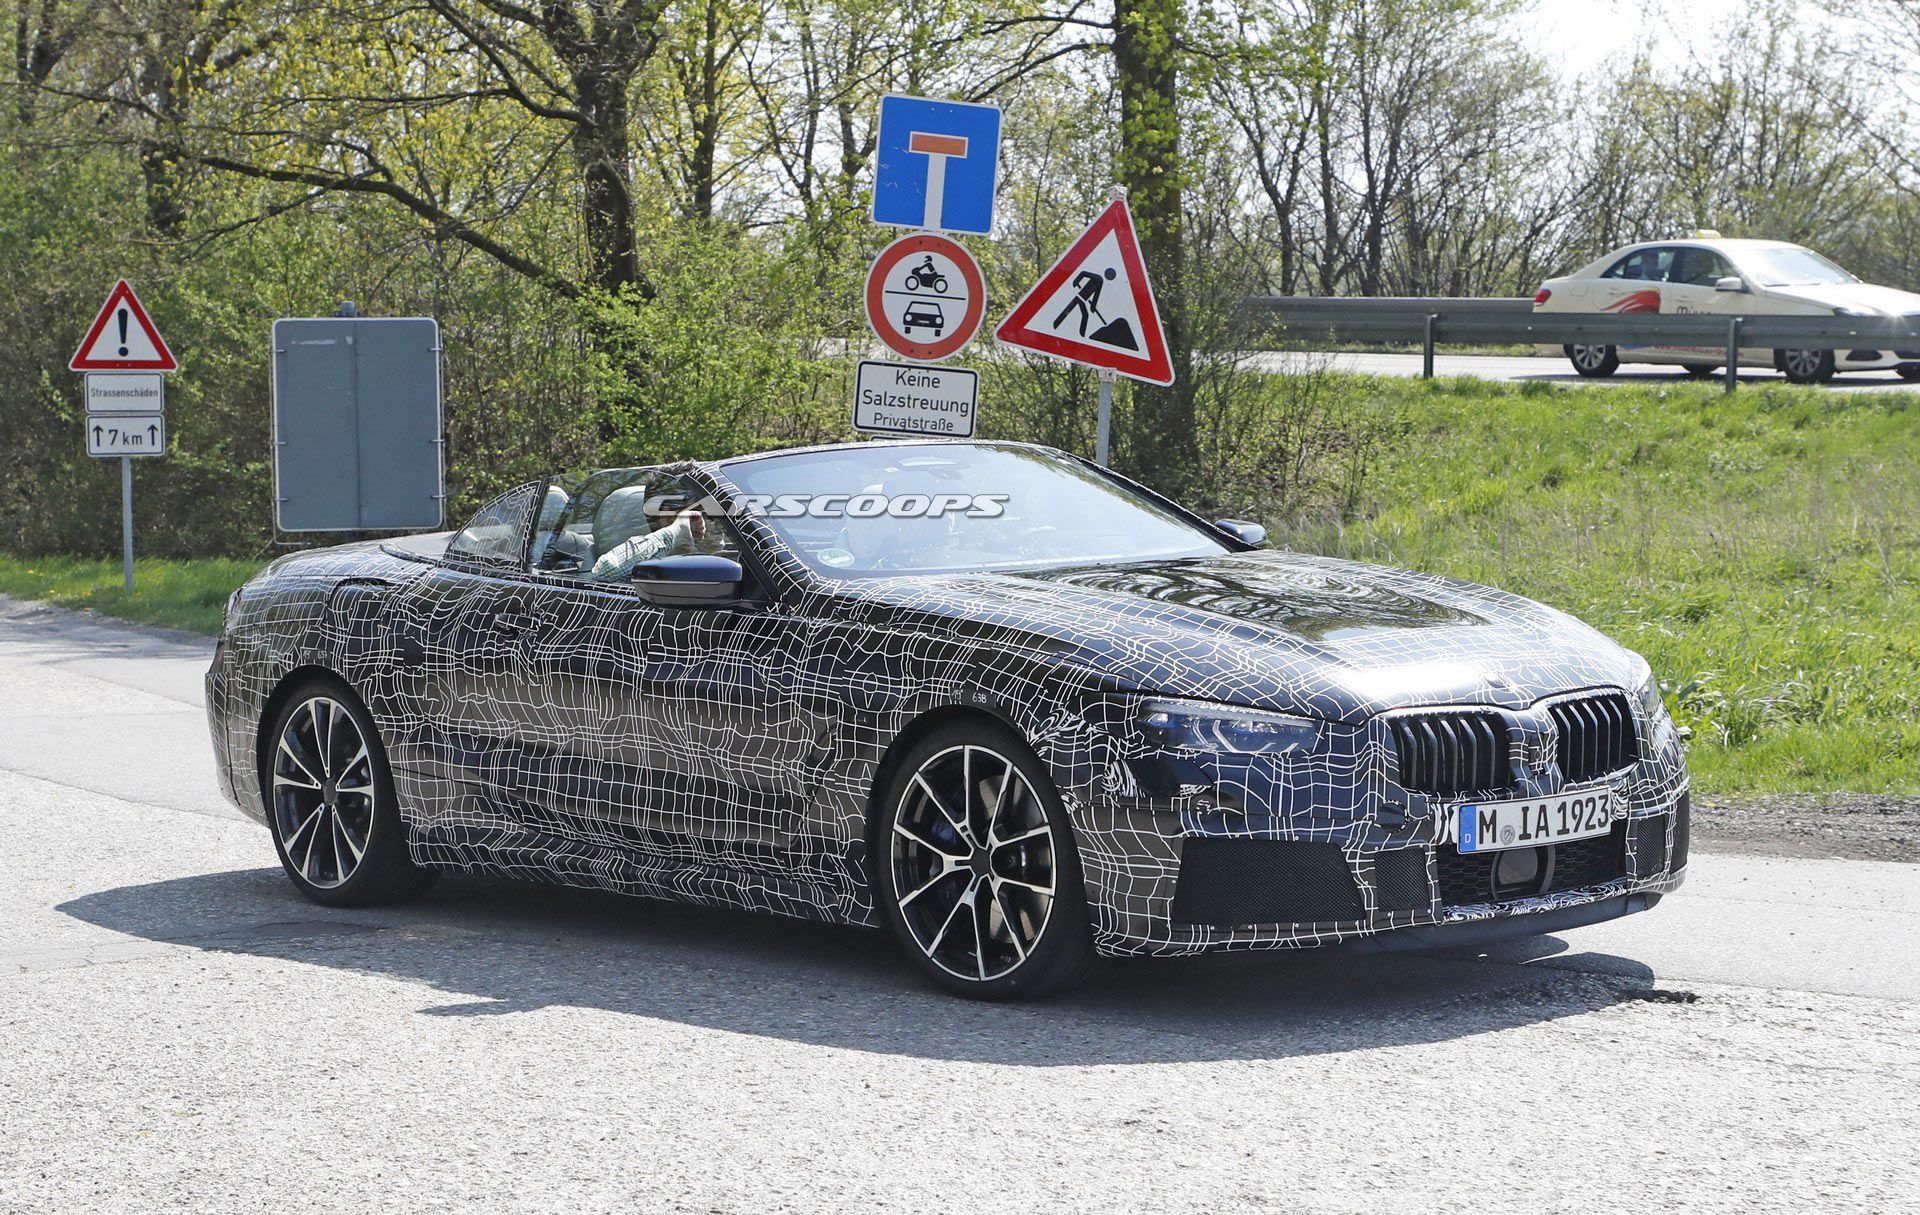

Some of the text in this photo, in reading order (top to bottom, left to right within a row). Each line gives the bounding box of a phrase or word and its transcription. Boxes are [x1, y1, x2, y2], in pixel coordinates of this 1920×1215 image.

[895, 370, 941, 389] Keine
[90, 388, 159, 398] Strassenschäden
[862, 389, 969, 418] Salzstreuung
[873, 412, 954, 432] Privatstraße
[108, 429, 143, 446] 7 km
[1478, 794, 1609, 845] M IA 1923
[1464, 833, 1471, 844] D
